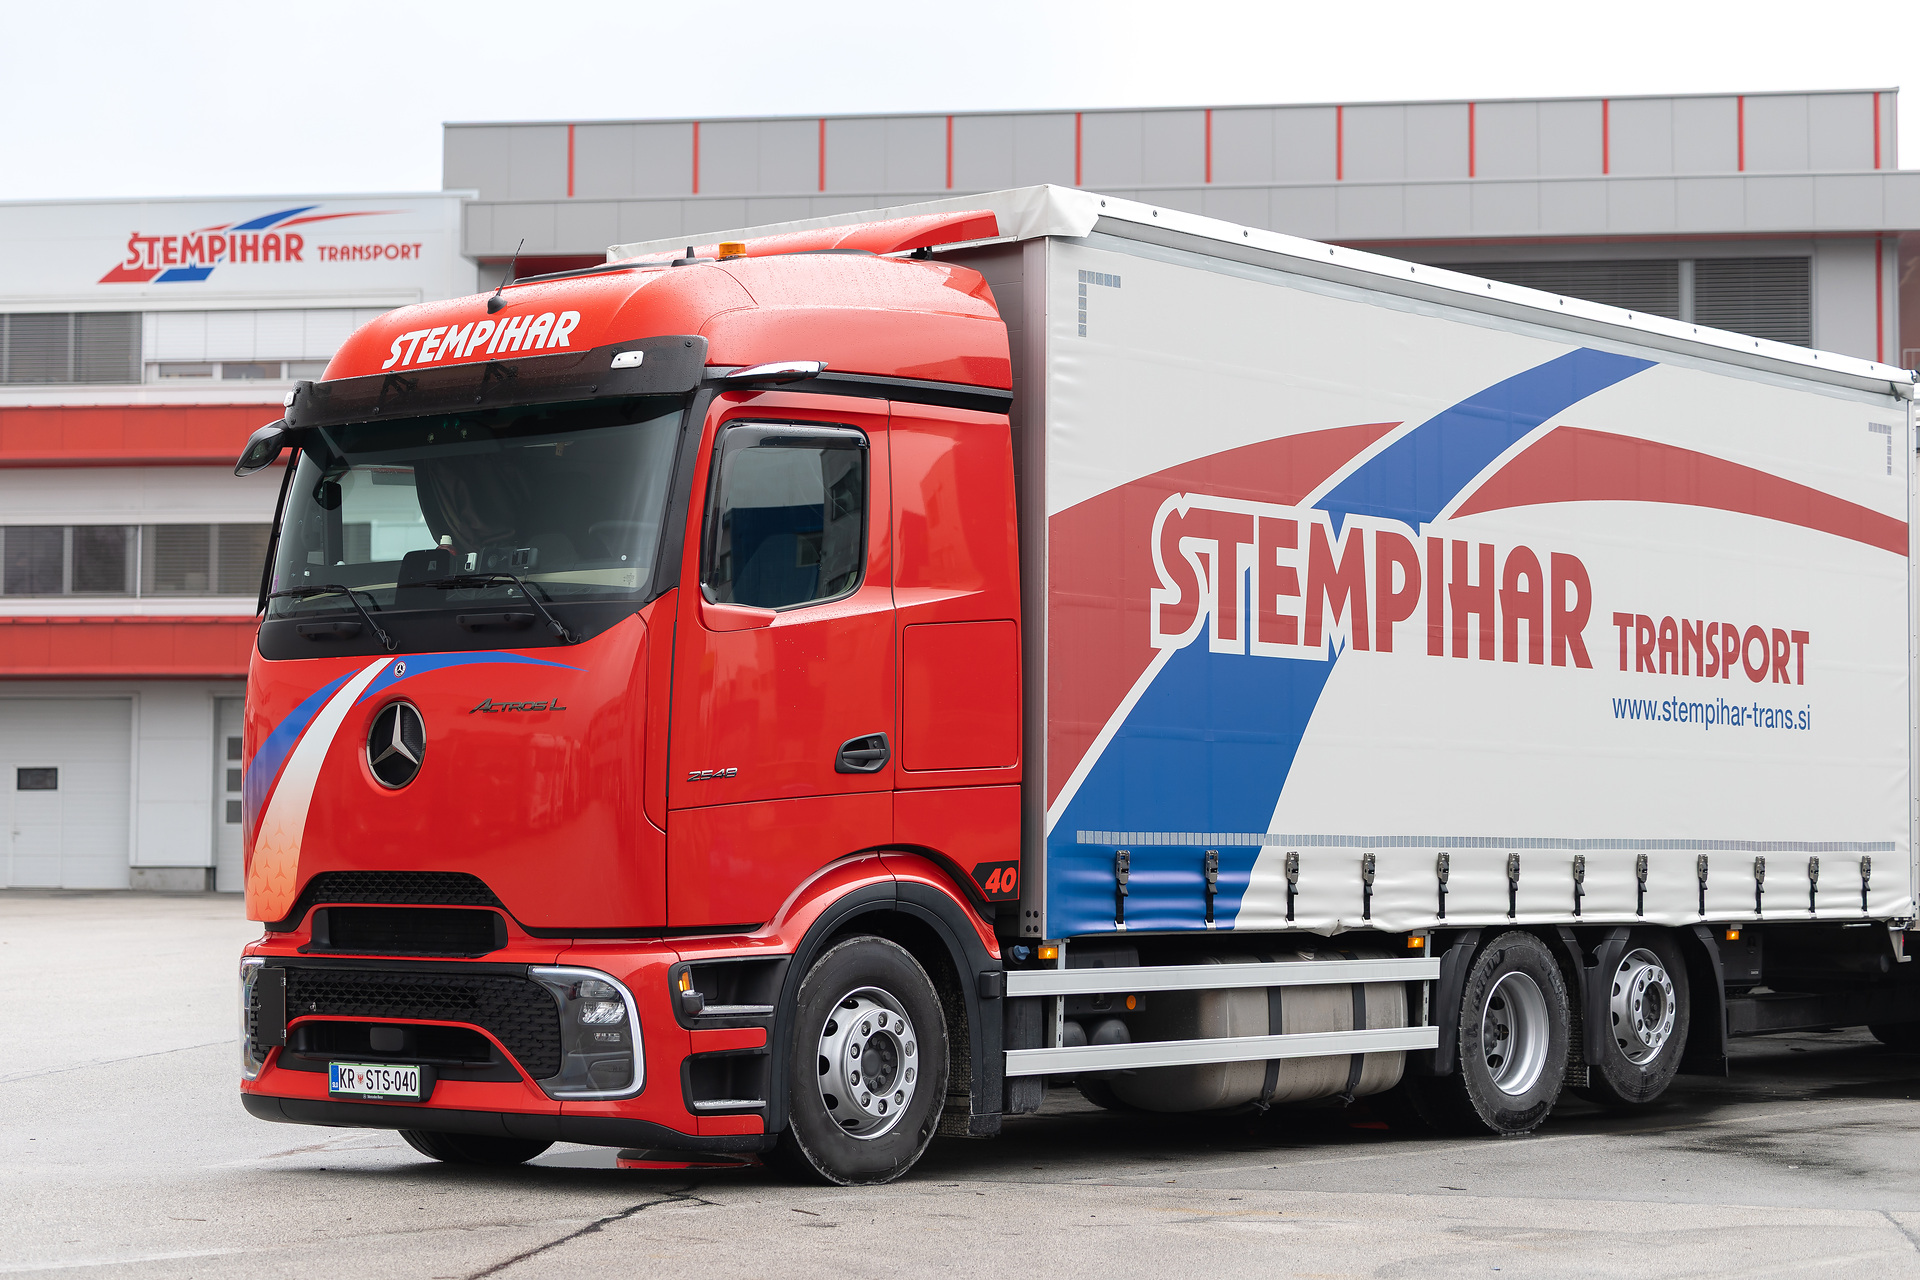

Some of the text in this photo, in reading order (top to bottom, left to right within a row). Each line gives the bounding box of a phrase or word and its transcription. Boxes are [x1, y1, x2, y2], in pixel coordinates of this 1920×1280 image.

[317, 243, 423, 262] TRANSPORT
[381, 310, 581, 370] STEMPIHAR
[1159, 506, 1810, 686] STEMPIHAR TRANSPORT
[549, 697, 567, 711] L
[1612, 695, 1811, 731] www.stempihar-trans.si
[686, 767, 738, 782] 2548
[984, 866, 1017, 894] 40
[339, 1067, 417, 1092] KR STS-040
